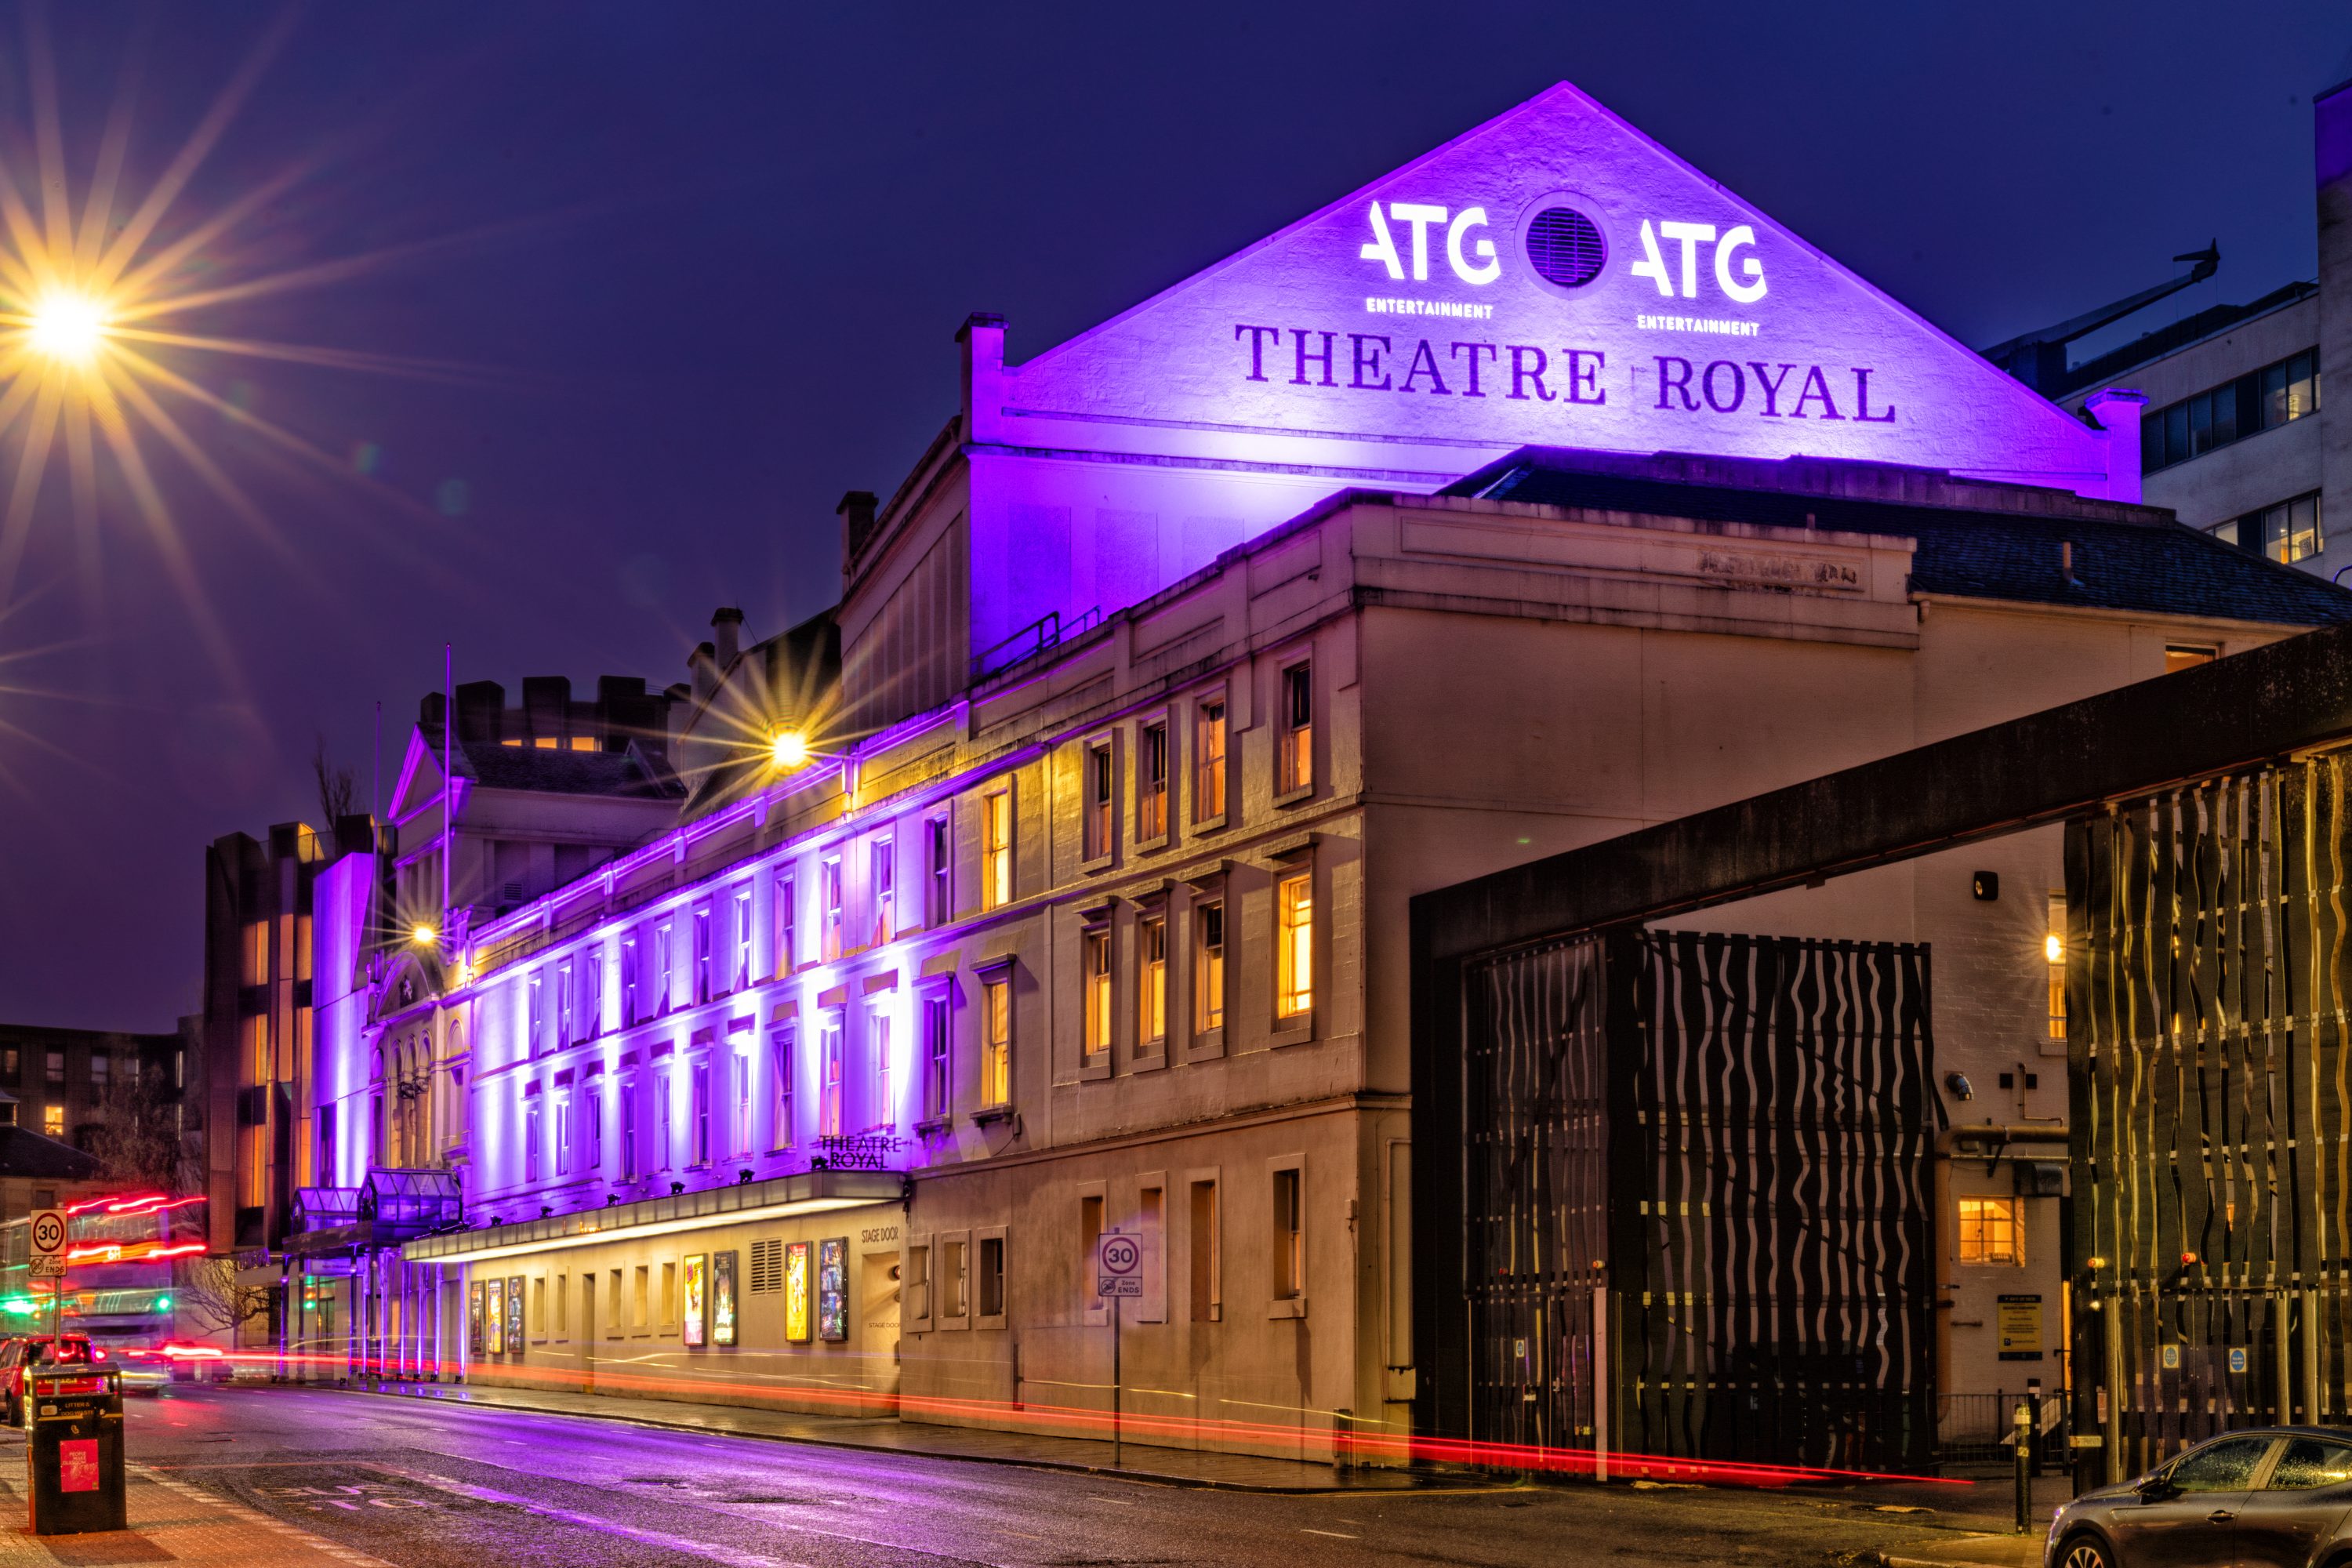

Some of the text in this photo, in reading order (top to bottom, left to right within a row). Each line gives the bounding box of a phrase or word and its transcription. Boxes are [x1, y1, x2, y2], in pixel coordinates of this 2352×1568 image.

[1360, 201, 1501, 285] ATG
[1631, 219, 1768, 303] ATG
[1366, 297, 1494, 319] ENTERTAINMENT
[1637, 314, 1760, 336] ENTERTAINMENT
[1235, 324, 1895, 423] THEATRE ROYAL
[819, 1135, 902, 1152] THEATRE
[831, 1152, 888, 1169] ROYAL
[38, 1224, 59, 1241] 30
[862, 1226, 898, 1243] STAGE DOOR
[1108, 1248, 1133, 1264] 30
